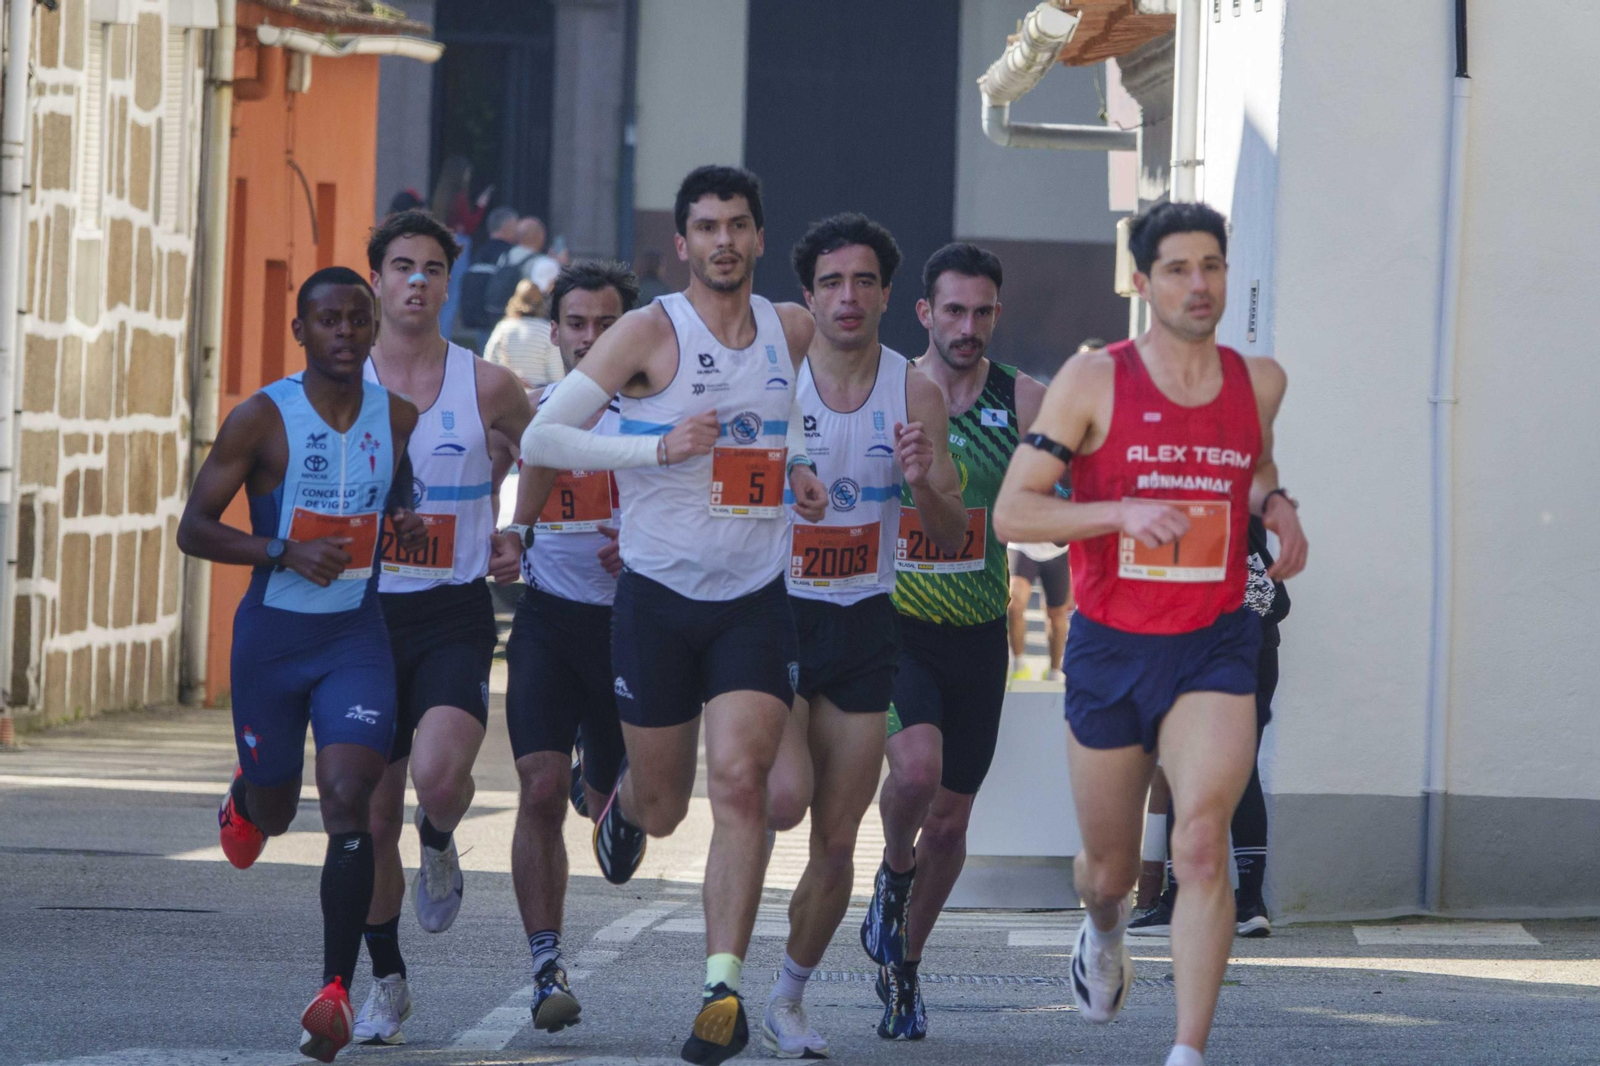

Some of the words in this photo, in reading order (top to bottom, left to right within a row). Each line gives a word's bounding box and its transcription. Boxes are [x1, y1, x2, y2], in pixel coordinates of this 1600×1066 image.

[305, 442, 327, 450] ZICO
[1126, 444, 1188, 463] ALEX
[1193, 446, 1252, 469] TEAM
[301, 487, 356, 499] CONCELLO
[748, 472, 765, 504] 5
[304, 499, 318, 509] DE
[320, 500, 350, 510] VIGO
[561, 489, 575, 520] 9
[803, 545, 869, 577] 2003
[344, 712, 377, 724] ZICO
